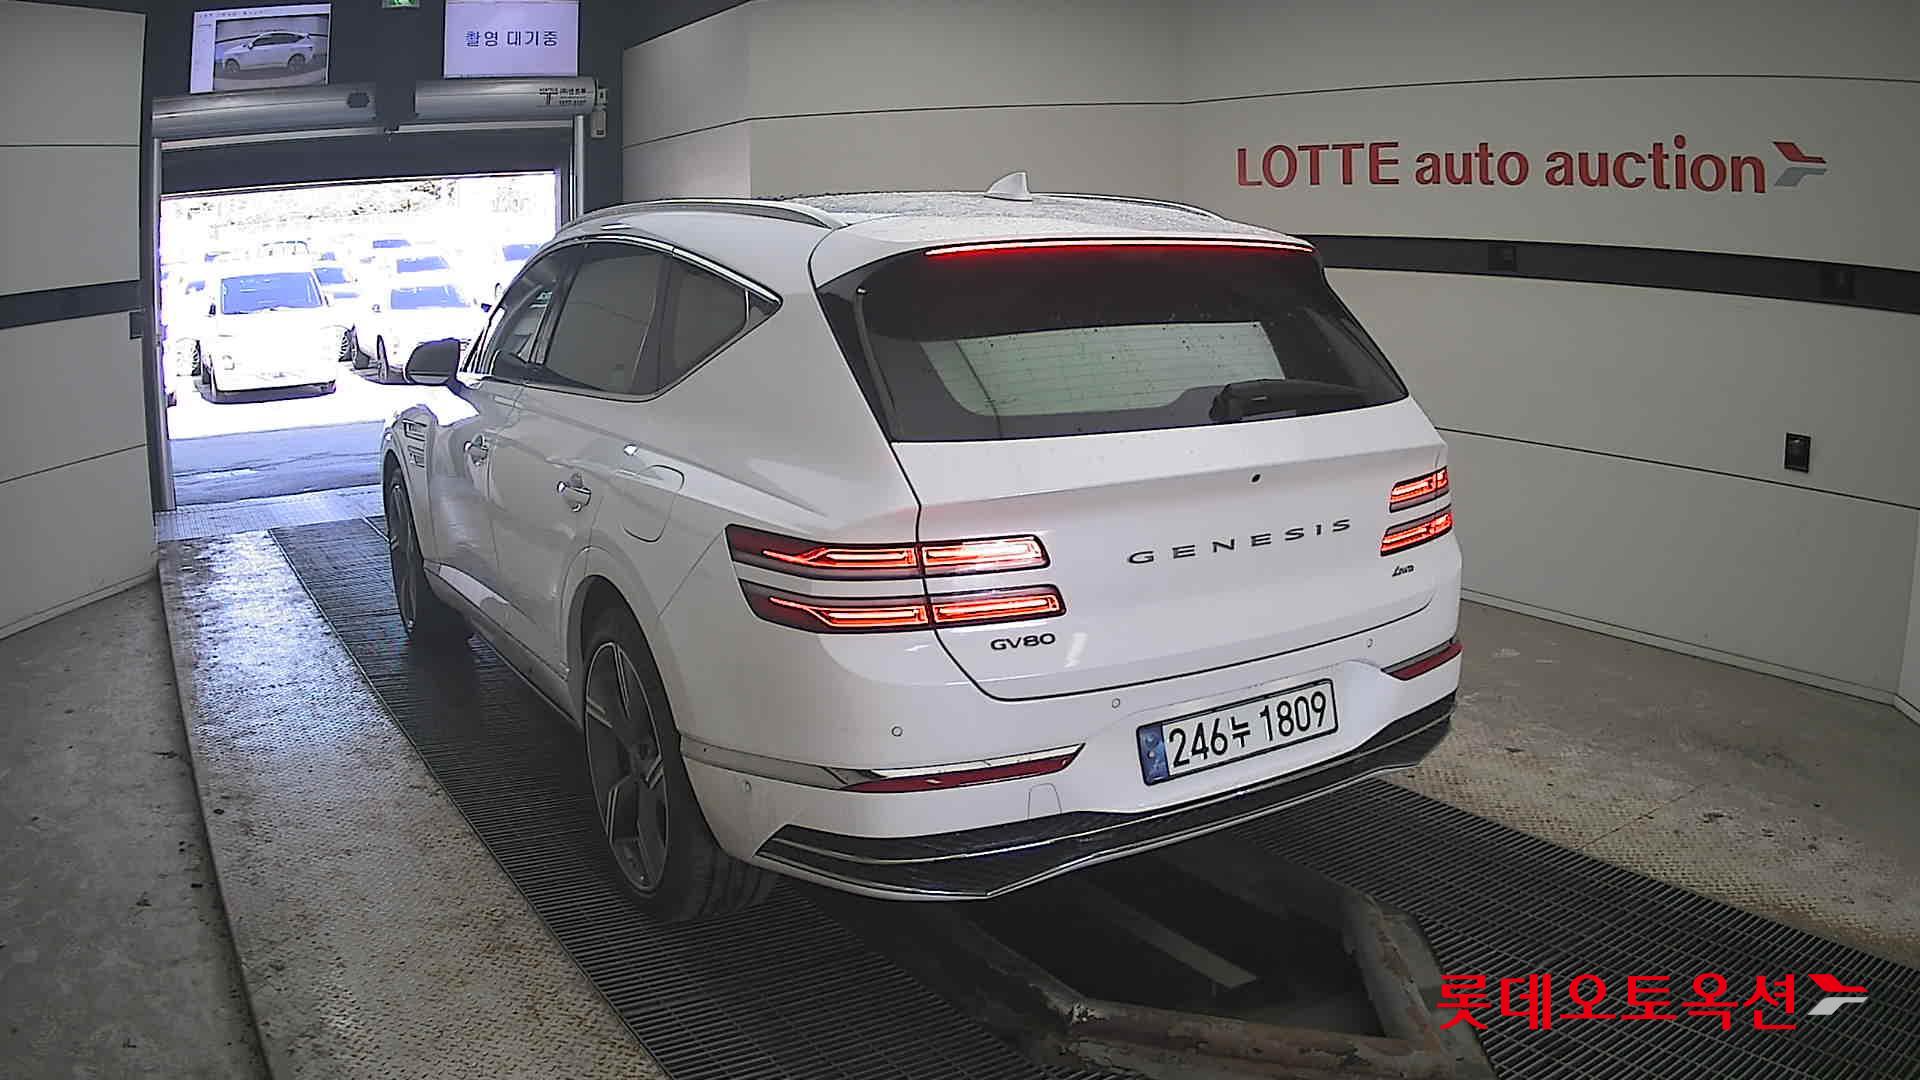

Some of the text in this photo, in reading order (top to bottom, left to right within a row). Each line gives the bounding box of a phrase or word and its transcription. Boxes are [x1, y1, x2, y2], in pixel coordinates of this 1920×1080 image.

[465, 30, 558, 47] 촬영 대기중
[1236, 134, 1766, 194] LOTTE auto auction
[1127, 518, 1351, 565] GENESIS
[989, 632, 1057, 652] GV80
[1168, 690, 1327, 769] 246누 1809
